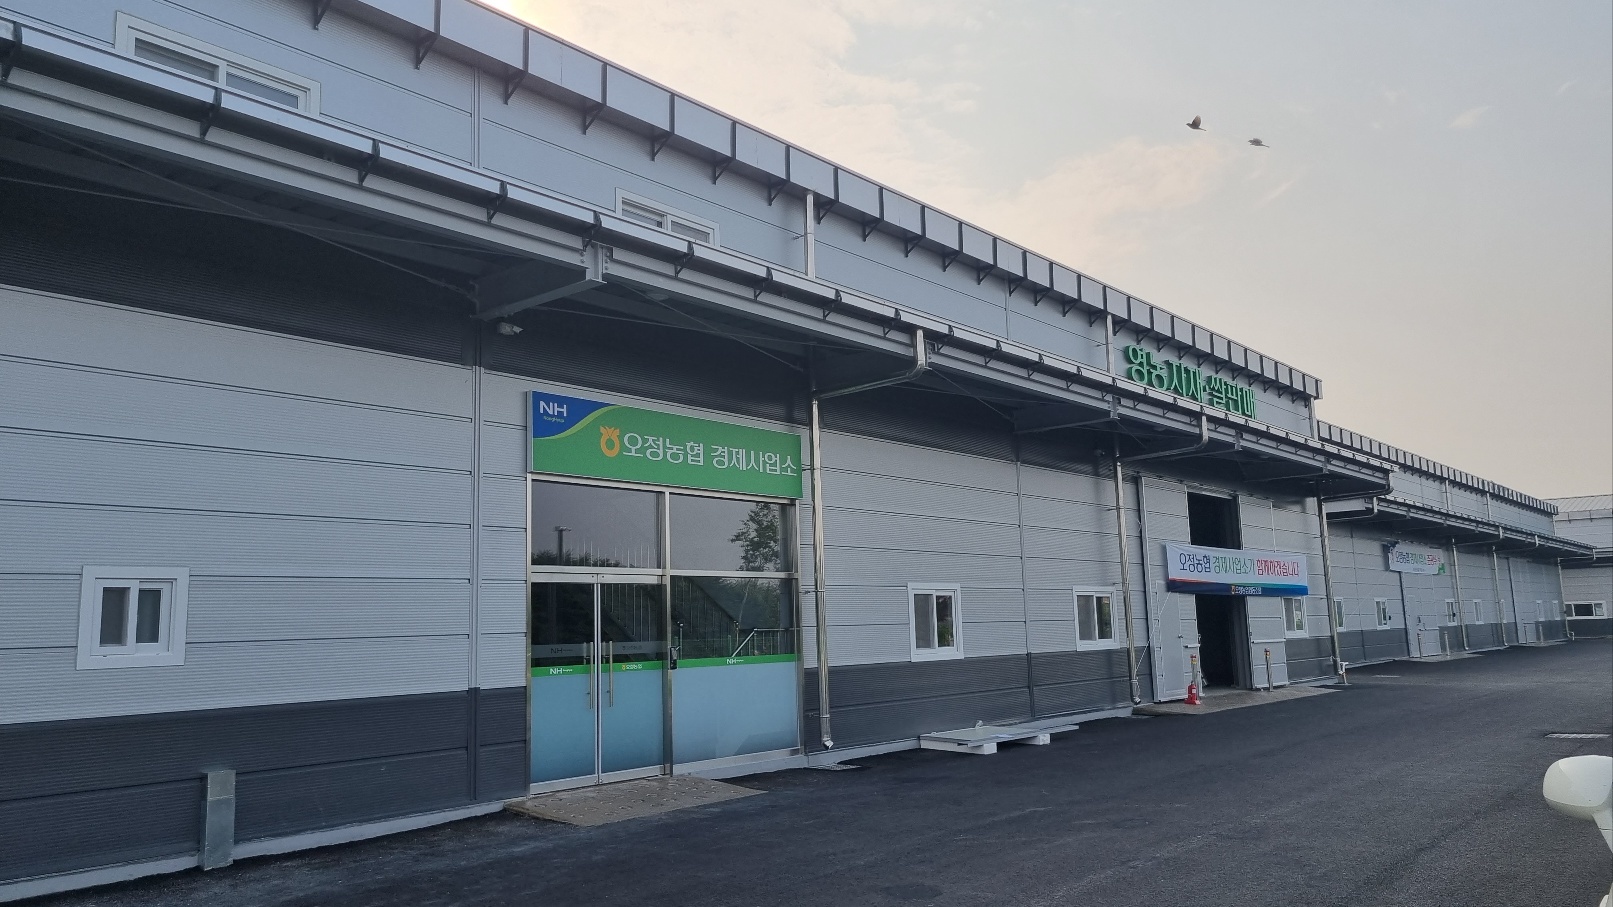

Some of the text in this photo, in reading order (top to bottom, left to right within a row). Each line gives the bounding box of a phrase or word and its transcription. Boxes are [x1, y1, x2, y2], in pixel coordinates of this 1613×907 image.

[540, 400, 567, 417] NH
[622, 432, 798, 477] 오정농협 경제사업소
[1179, 552, 1299, 577] 오정농협 경제사업소가 함께하겠습니다
[549, 667, 563, 675] NH
